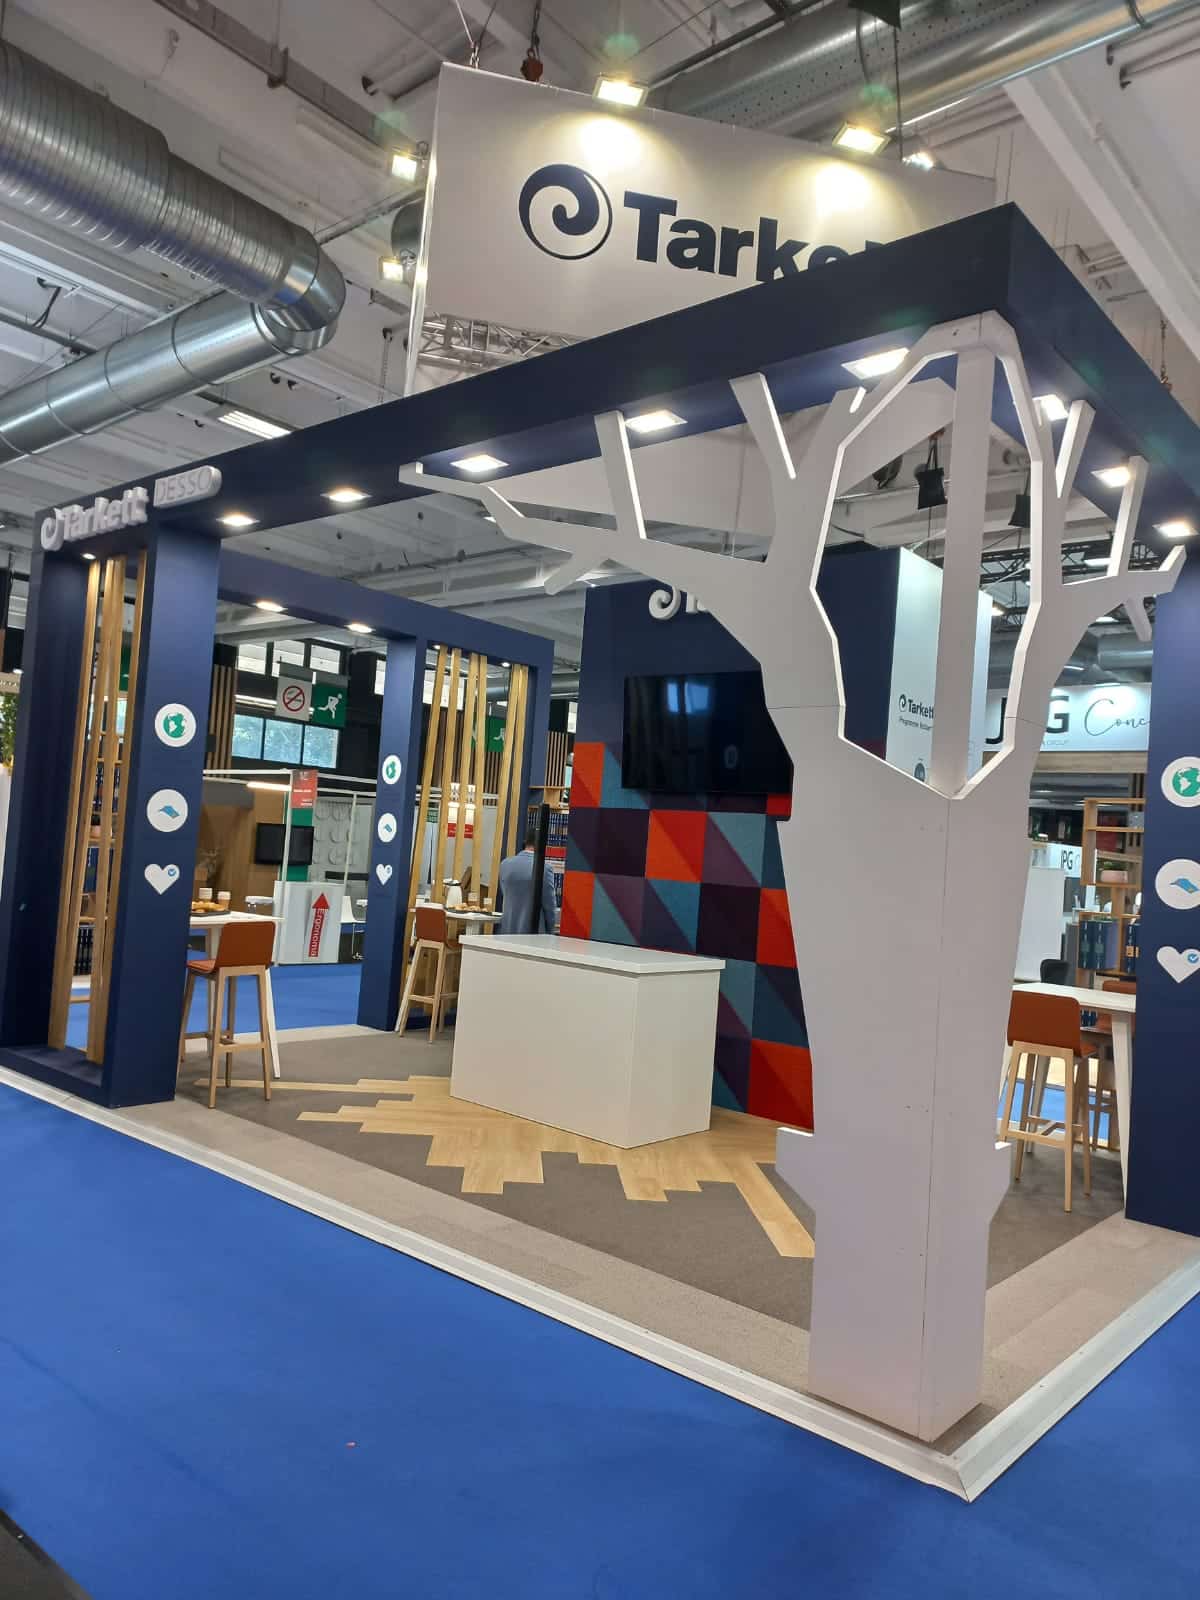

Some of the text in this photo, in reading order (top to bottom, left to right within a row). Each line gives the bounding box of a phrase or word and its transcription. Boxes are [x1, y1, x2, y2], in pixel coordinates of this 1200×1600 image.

[623, 190, 886, 283] Tark
[62, 467, 212, 542] Tarkett DESSO
[985, 695, 1149, 745] JG Conc
